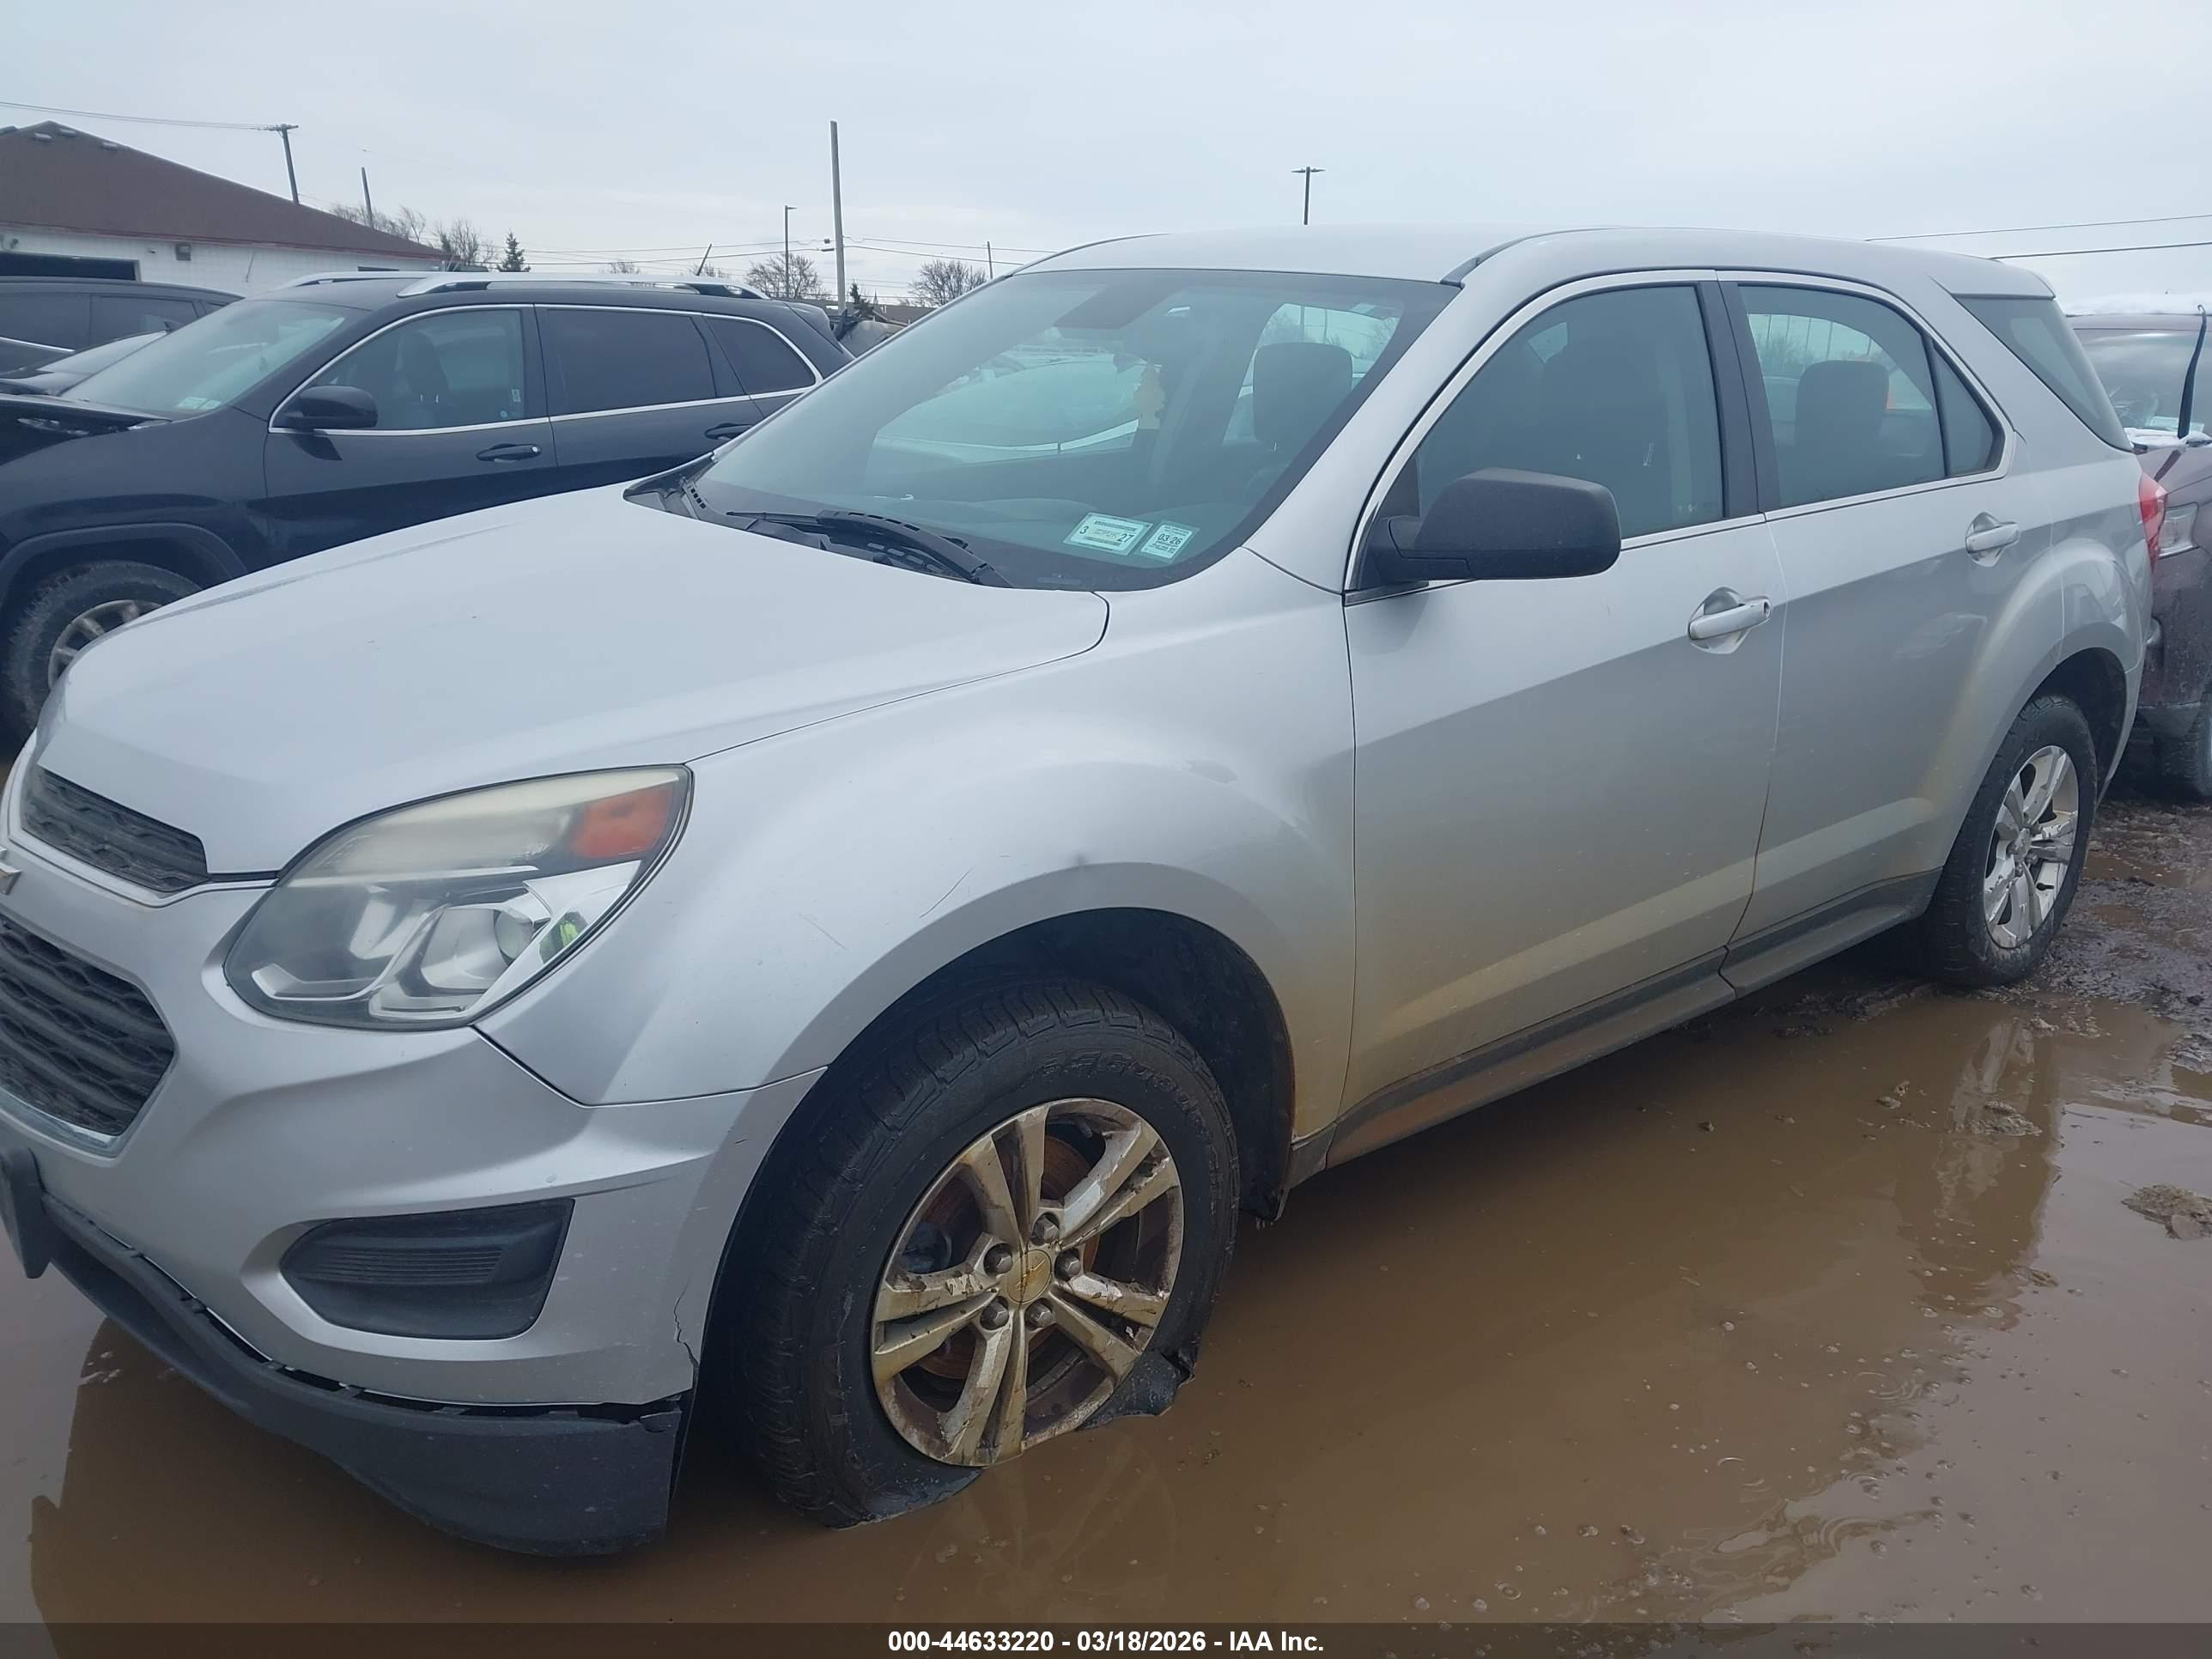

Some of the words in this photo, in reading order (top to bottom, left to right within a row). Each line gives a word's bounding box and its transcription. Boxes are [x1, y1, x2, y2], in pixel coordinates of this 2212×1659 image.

[1079, 526, 1090, 534] 3
[1116, 532, 1135, 543] 27
[1158, 533, 1170, 542] 03
[1170, 536, 1183, 545] 26
